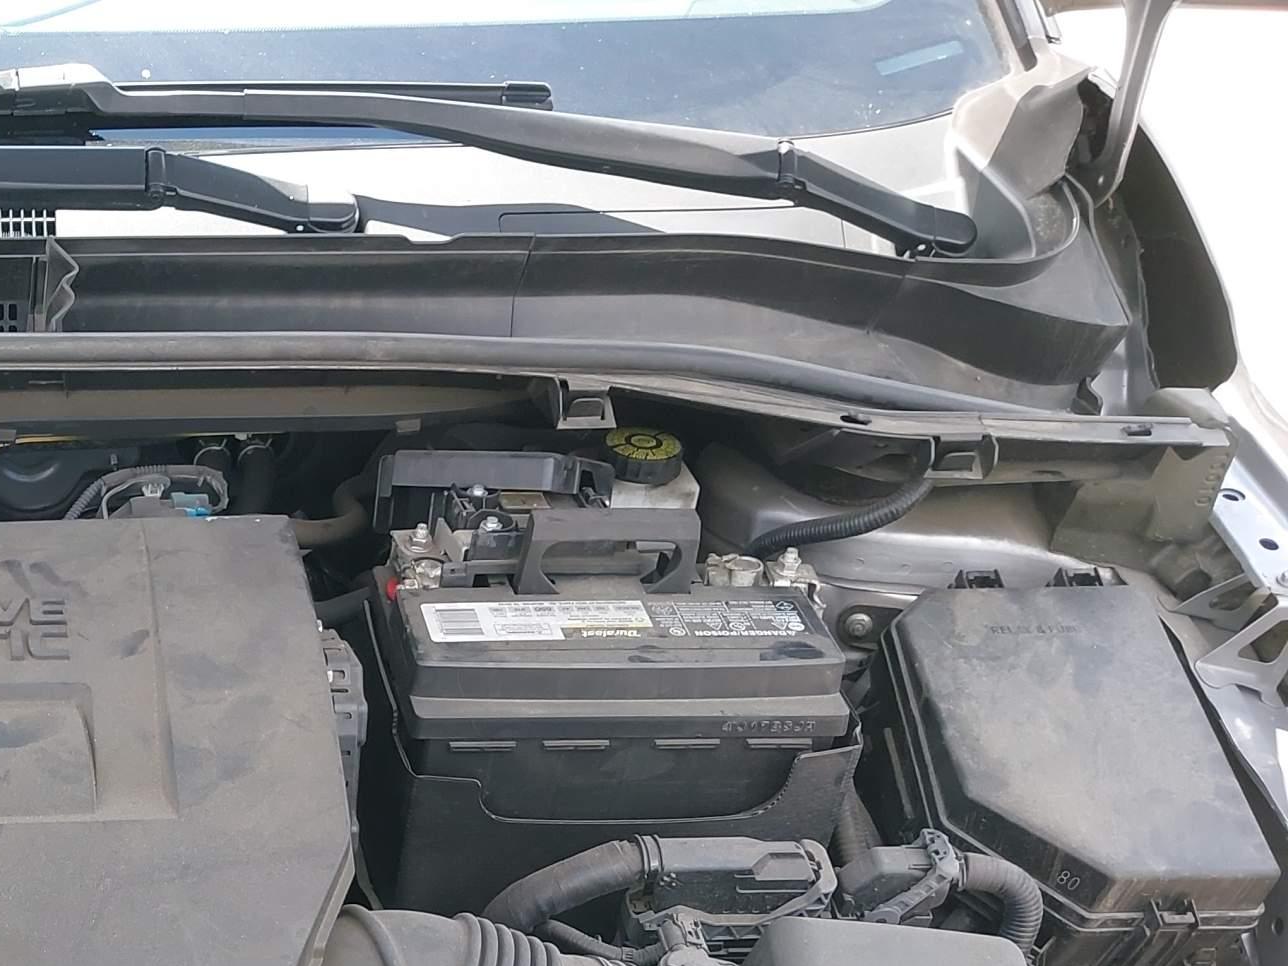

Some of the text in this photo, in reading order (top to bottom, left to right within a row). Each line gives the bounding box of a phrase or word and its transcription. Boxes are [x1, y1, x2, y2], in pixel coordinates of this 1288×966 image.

[582, 628, 641, 639] Duralast
[693, 629, 786, 638] DANGER/POISON
[1056, 870, 1080, 890] 80
